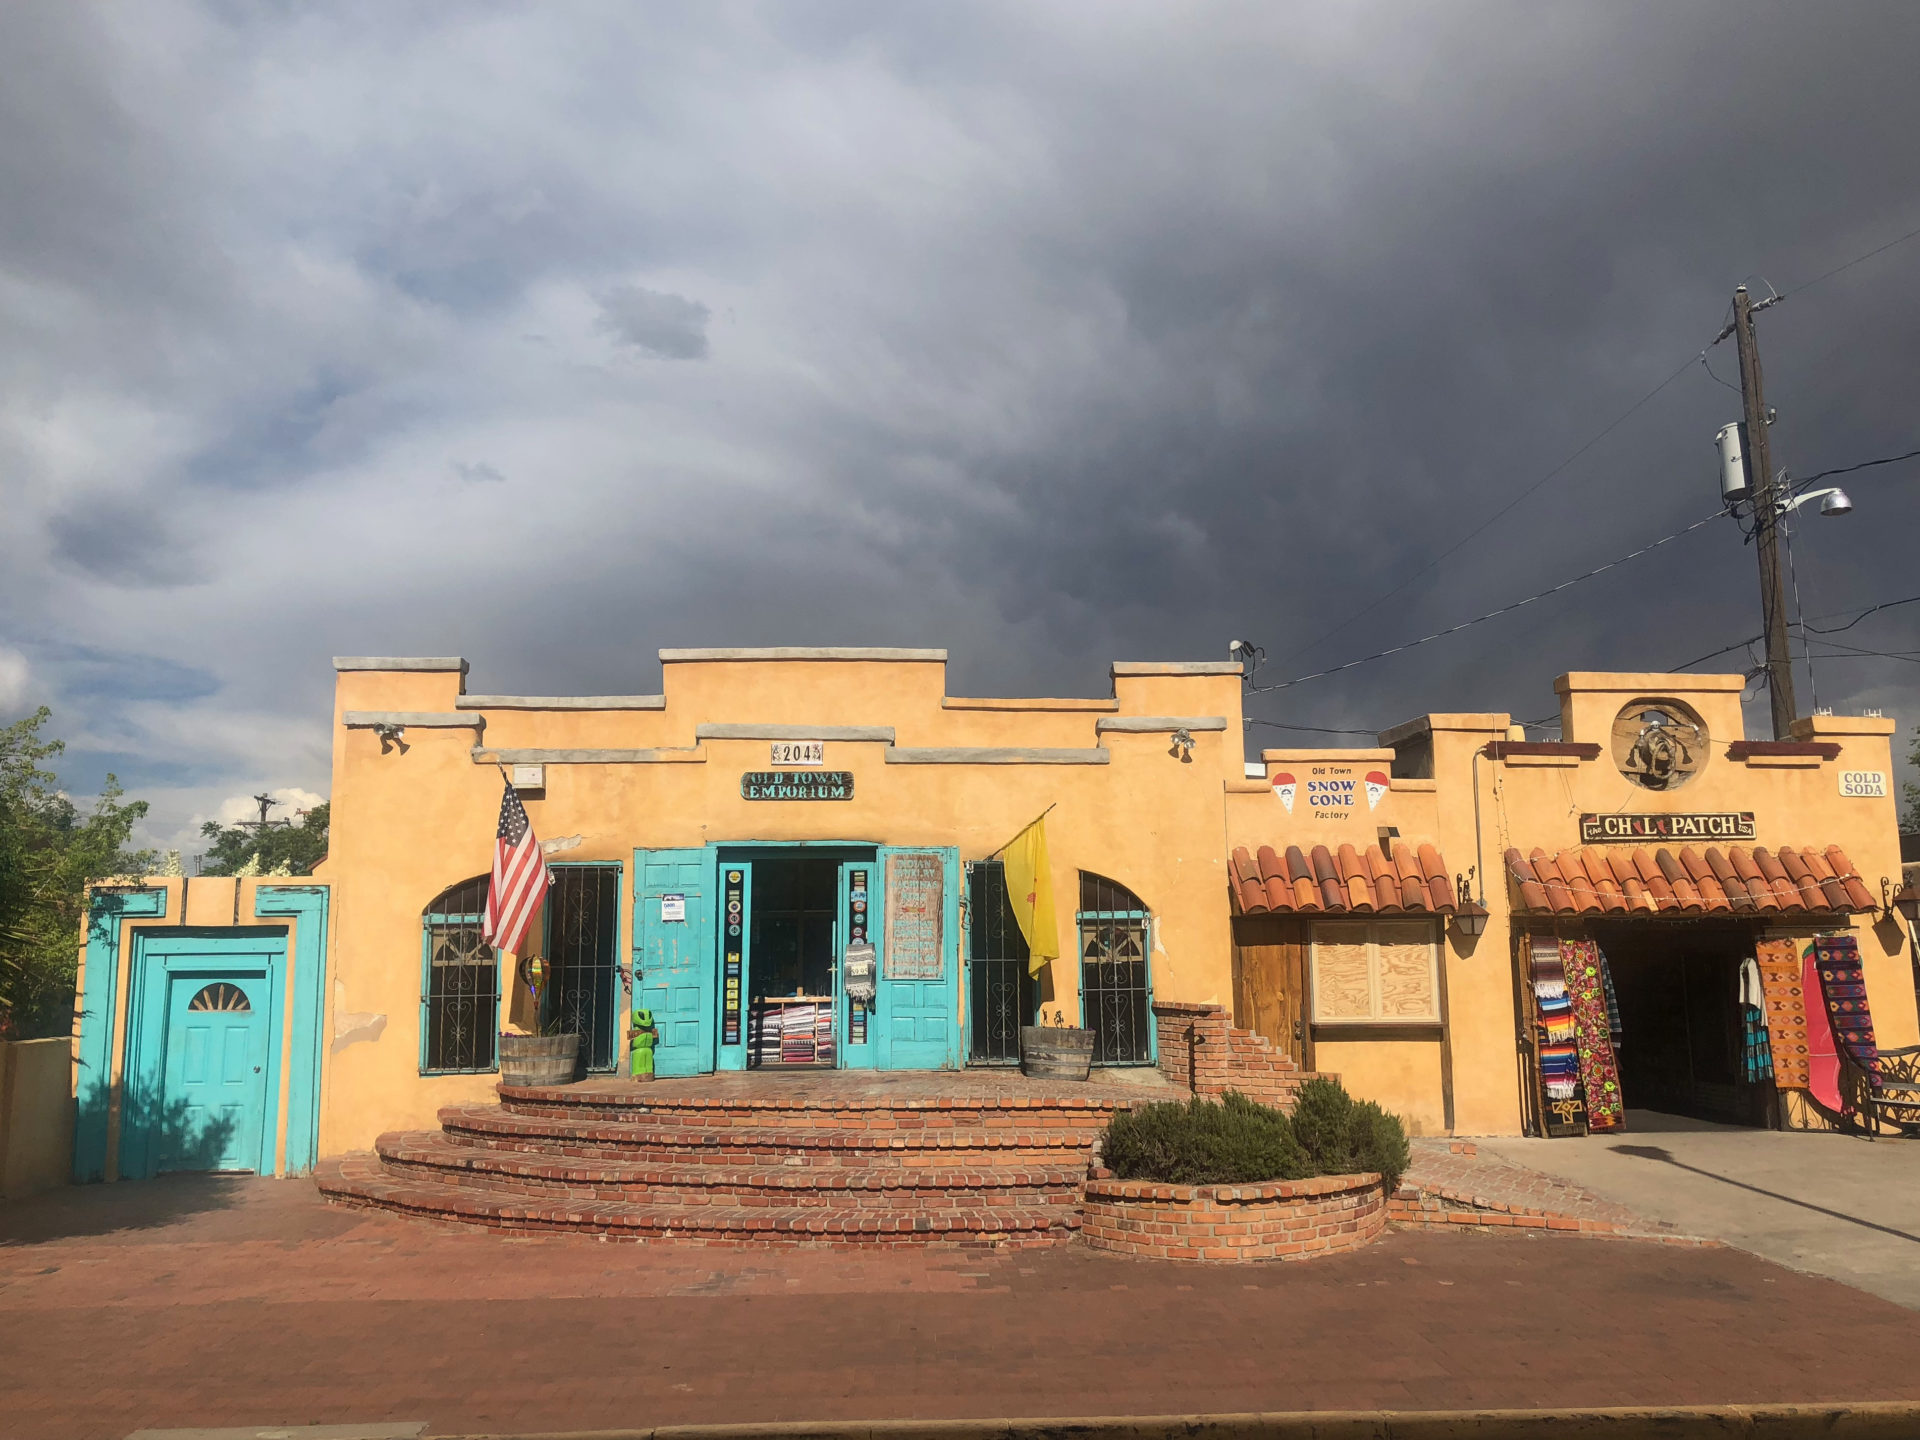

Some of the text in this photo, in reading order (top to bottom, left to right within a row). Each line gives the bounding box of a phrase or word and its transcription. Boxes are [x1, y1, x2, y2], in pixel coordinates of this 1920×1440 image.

[783, 745, 811, 762] 204
[1312, 767, 1351, 775] Old Town
[751, 772, 843, 785] OLD TOWN
[1844, 772, 1882, 784] COLD
[749, 785, 845, 799] EMPORIUM
[1308, 780, 1356, 792] SNOW
[1845, 784, 1884, 795] SODA
[1310, 794, 1354, 806] CONE
[1315, 811, 1349, 820] Factory
[1588, 827, 1602, 835] the
[1671, 816, 1736, 835] PATCH
[1738, 824, 1752, 835] USA
